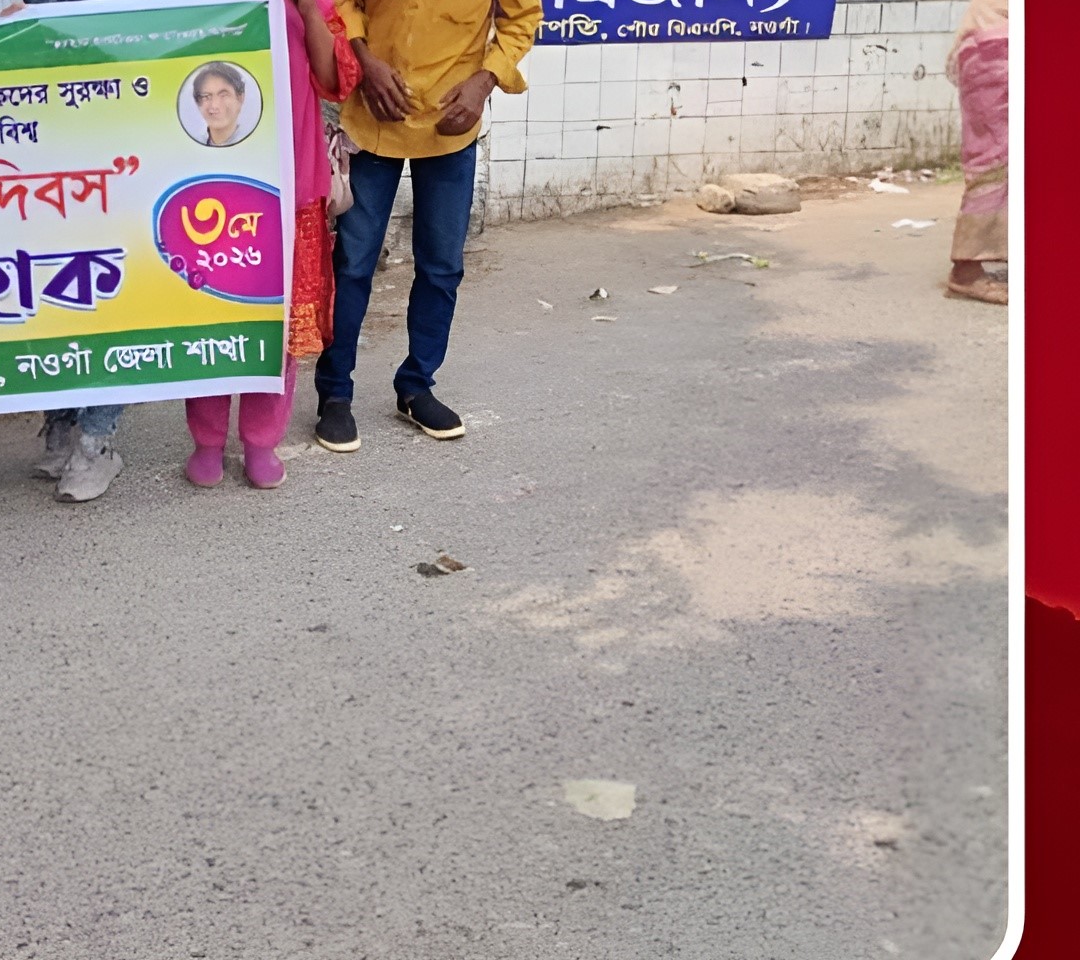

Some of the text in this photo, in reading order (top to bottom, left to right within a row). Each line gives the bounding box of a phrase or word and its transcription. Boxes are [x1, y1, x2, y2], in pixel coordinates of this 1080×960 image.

[57, 78, 122, 109] সুরক্ষা
[131, 76, 149, 97] ও
[195, 245, 262, 272] ২০২৬
[15, 341, 93, 381] নওগাঁ
[103, 339, 175, 373] জেলা
